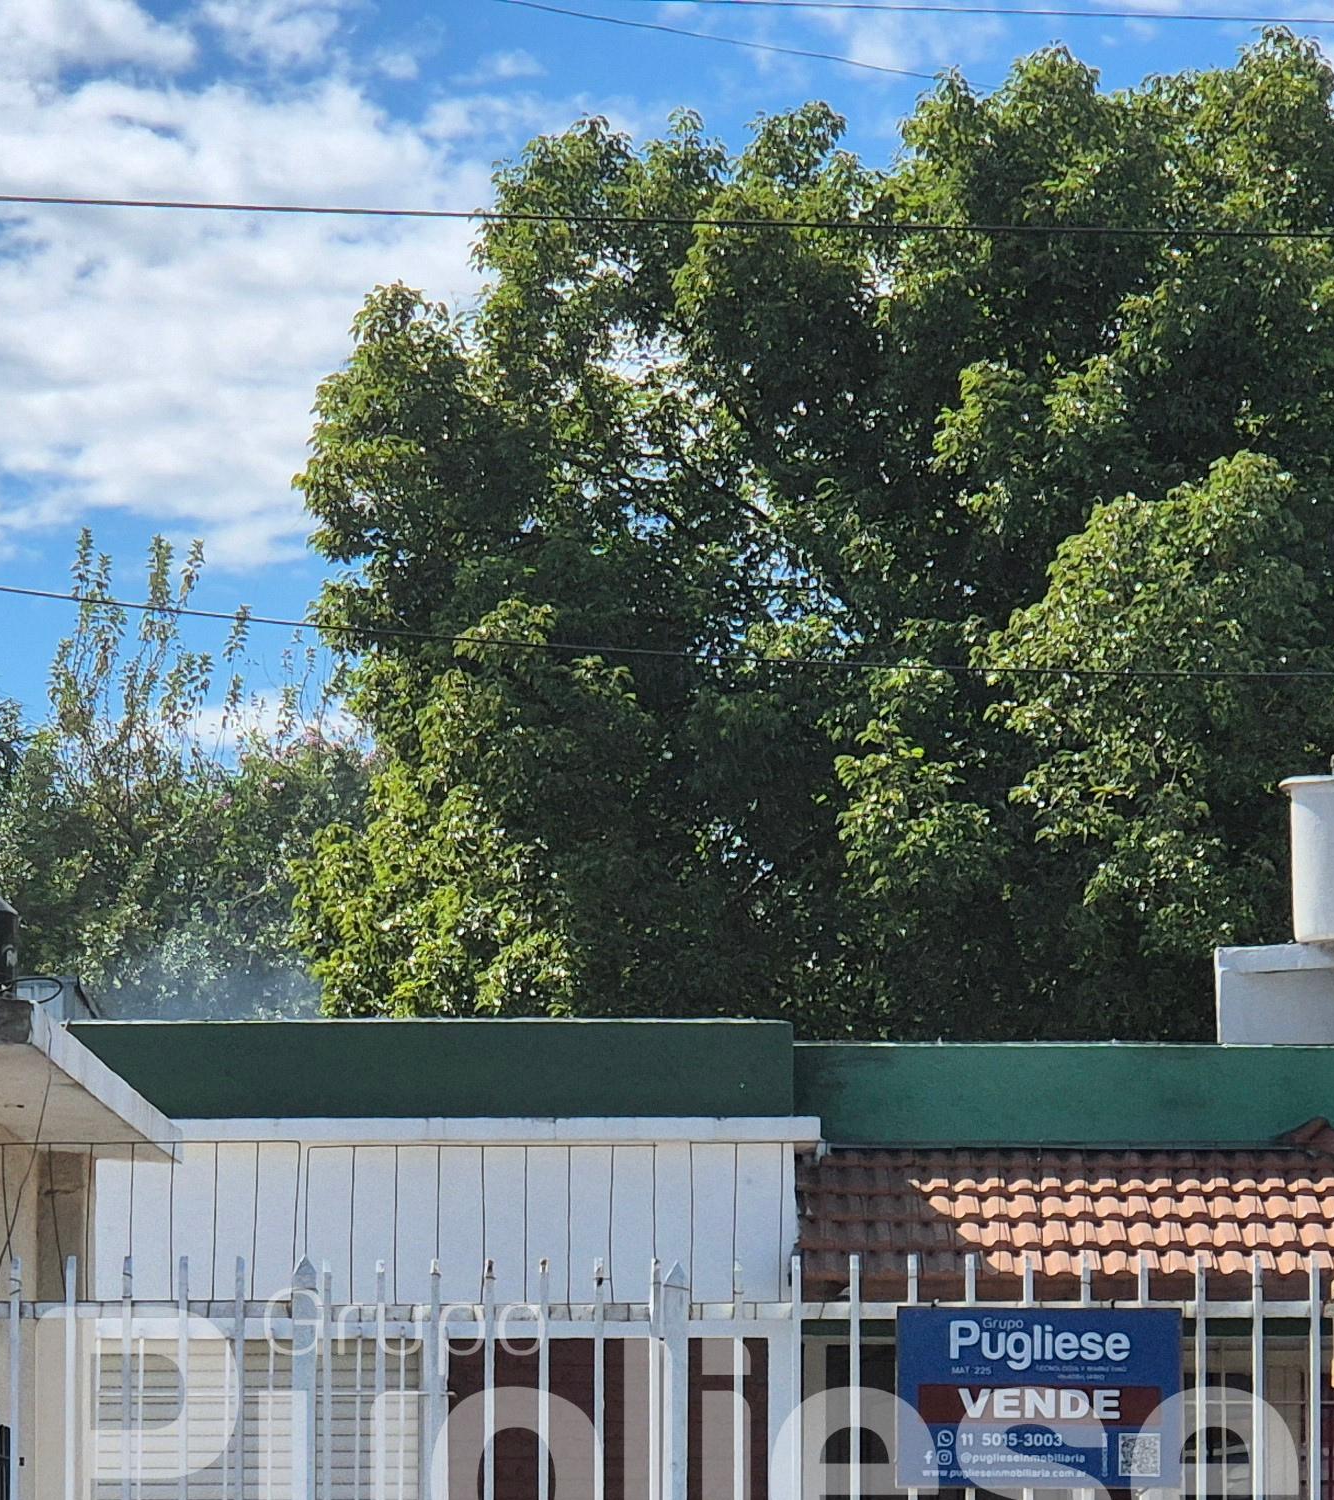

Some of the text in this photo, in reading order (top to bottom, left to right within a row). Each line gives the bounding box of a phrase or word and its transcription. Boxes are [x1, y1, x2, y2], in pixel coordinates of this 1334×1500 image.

[982, 1317, 1024, 1331] Grupo
[949, 1319, 1131, 1371] Pugliese
[974, 1366, 992, 1375] 225
[958, 1388, 1121, 1420] VENDE
[960, 1433, 1063, 1447] 11 5015-3003
